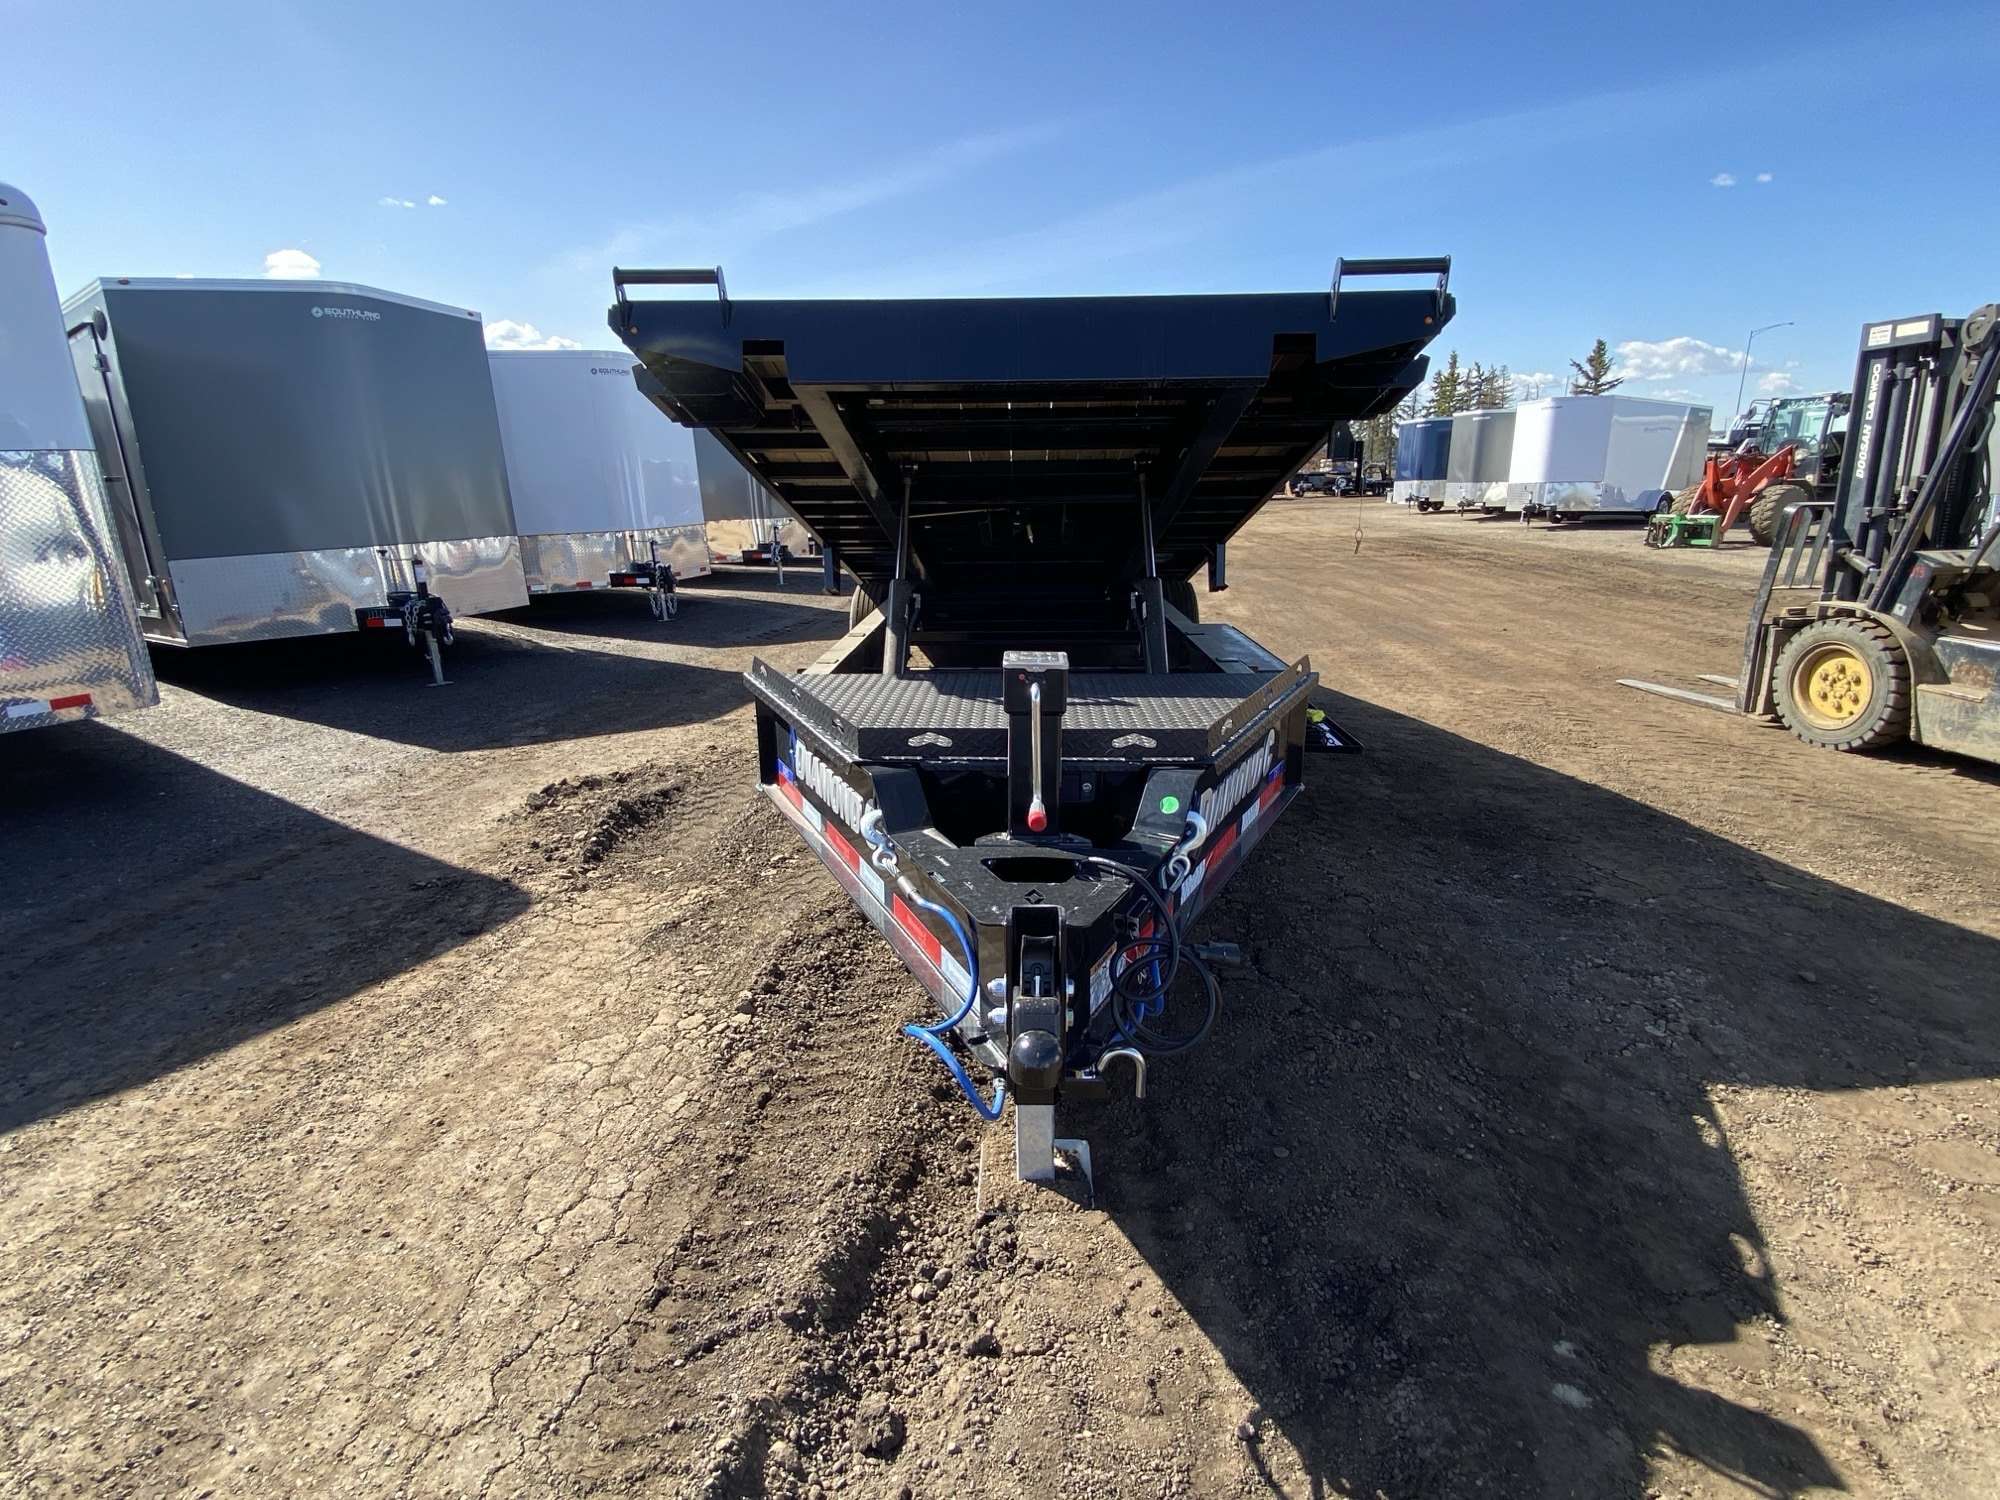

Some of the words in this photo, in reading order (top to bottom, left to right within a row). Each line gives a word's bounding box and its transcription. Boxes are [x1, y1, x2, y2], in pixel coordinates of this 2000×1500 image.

[324, 307, 381, 320] SOUTHLAND
[598, 367, 630, 376] SOUTHLA
[1855, 423, 1872, 479] DOOSAN
[1865, 363, 1881, 421] DAEWOO
[795, 738, 864, 835] DIAMOND
